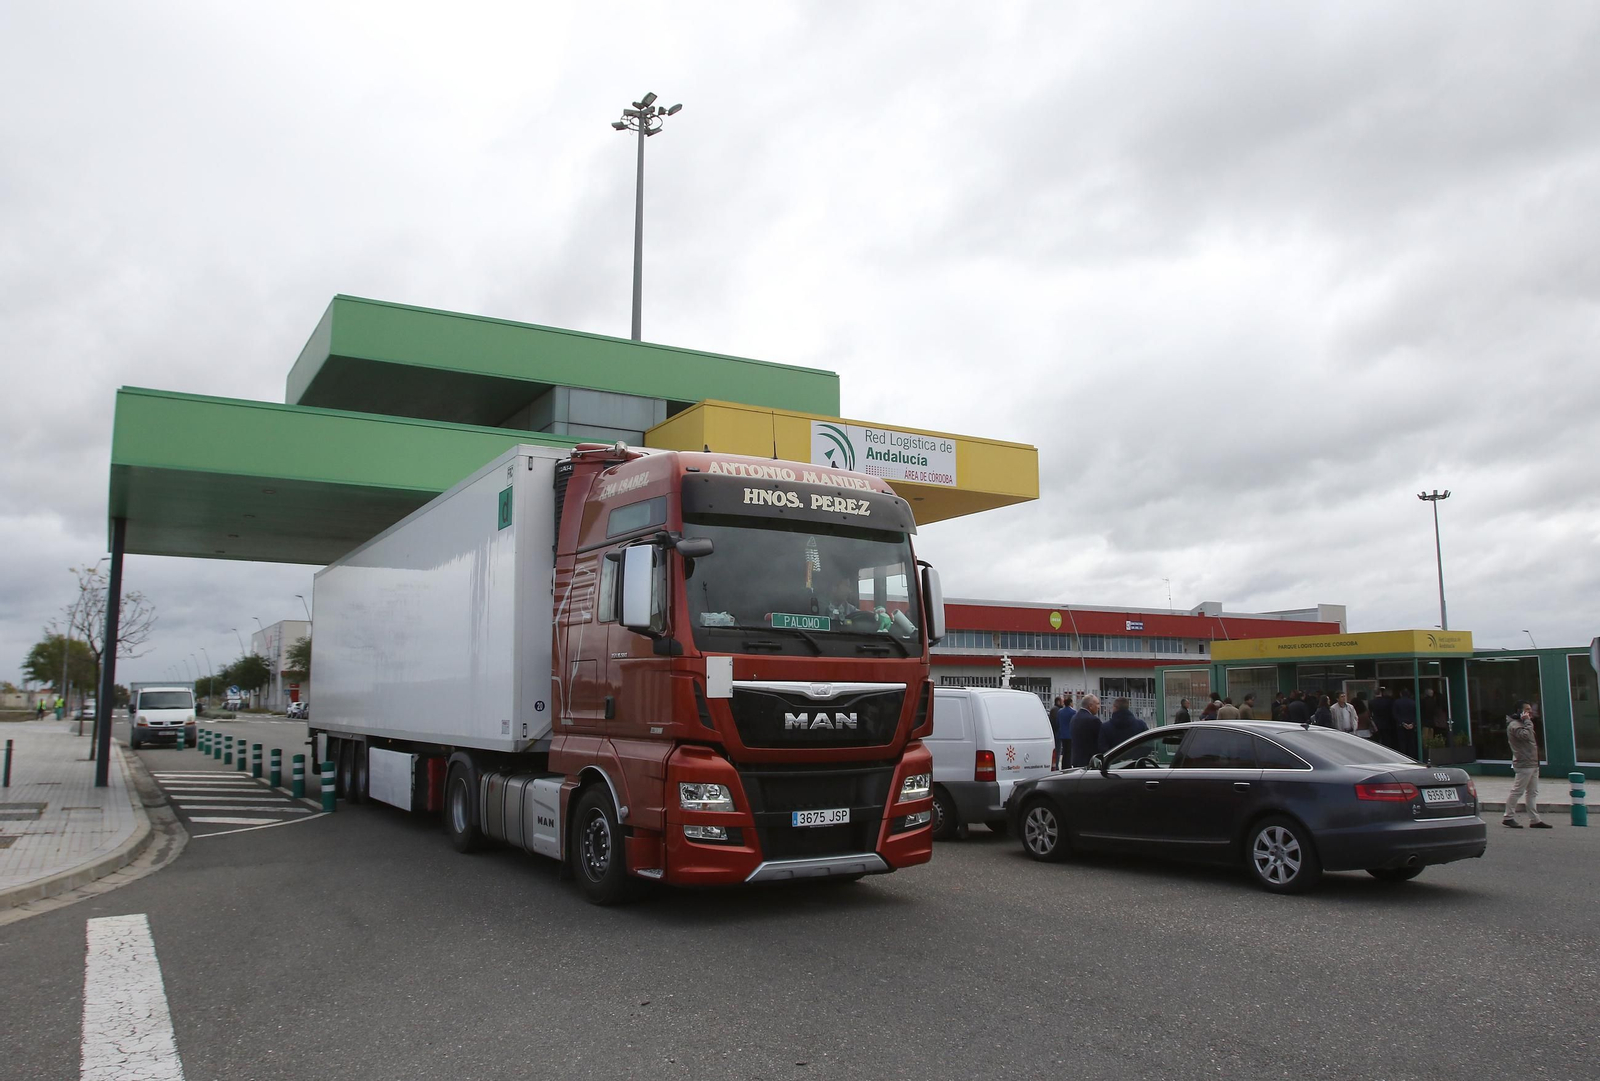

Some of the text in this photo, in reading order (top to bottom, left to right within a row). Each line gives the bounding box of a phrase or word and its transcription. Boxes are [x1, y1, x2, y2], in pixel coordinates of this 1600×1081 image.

[865, 430, 953, 454] Red Logística de
[866, 447, 928, 466] Andalucía
[617, 471, 650, 494] ISABEL
[708, 461, 877, 492] ANTONIO MANUEL
[919, 471, 928, 481] DE
[928, 470, 953, 485] CÓRDOBA
[743, 488, 871, 516] HNOS. PEREZ
[784, 615, 820, 629] PALOMO
[536, 701, 544, 711] 20
[784, 712, 858, 730] MAN
[1427, 789, 1457, 801] 6358 GPY
[537, 815, 555, 828] MAN
[799, 810, 848, 824] 3675 JSP
